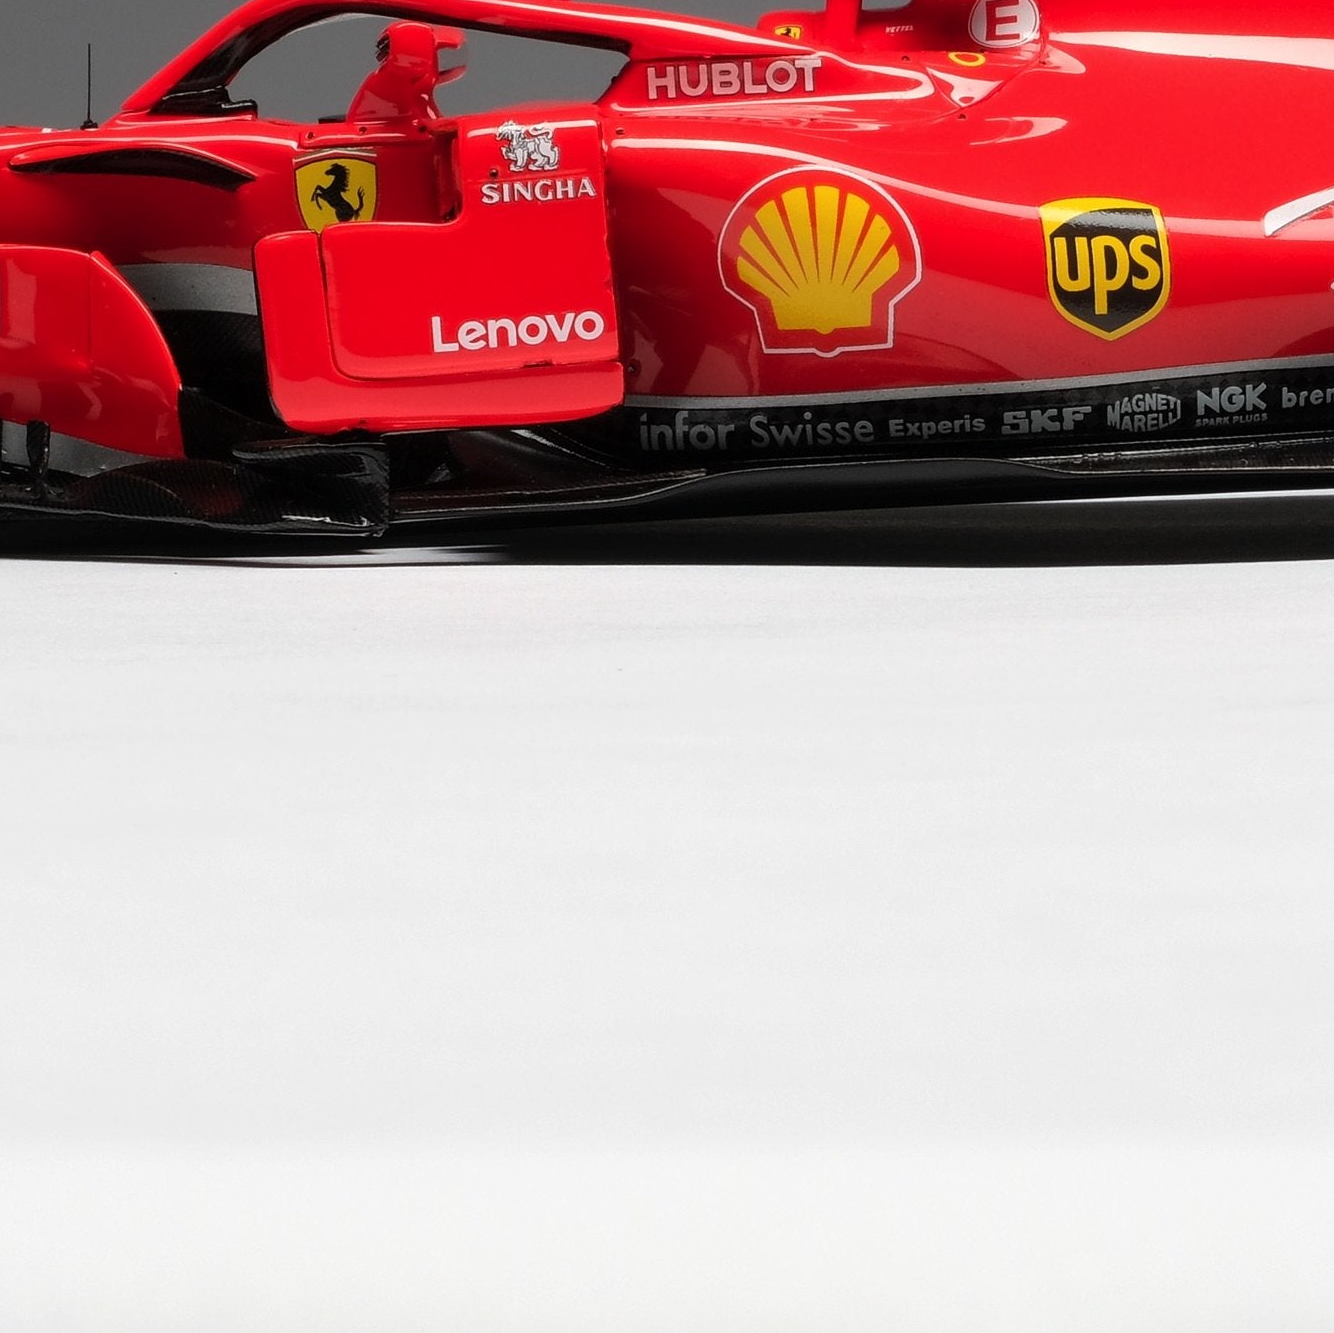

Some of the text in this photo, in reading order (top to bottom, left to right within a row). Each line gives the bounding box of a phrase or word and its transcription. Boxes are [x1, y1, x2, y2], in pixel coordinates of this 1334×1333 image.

[647, 59, 822, 100] HUBLOT
[481, 177, 597, 204] SINGHA
[431, 311, 605, 353] Lenovo
[1196, 382, 1267, 416] NGK
[639, 406, 1092, 451] infor Swisse Experis SKF
[1195, 412, 1268, 428] SPARK PLUGS
